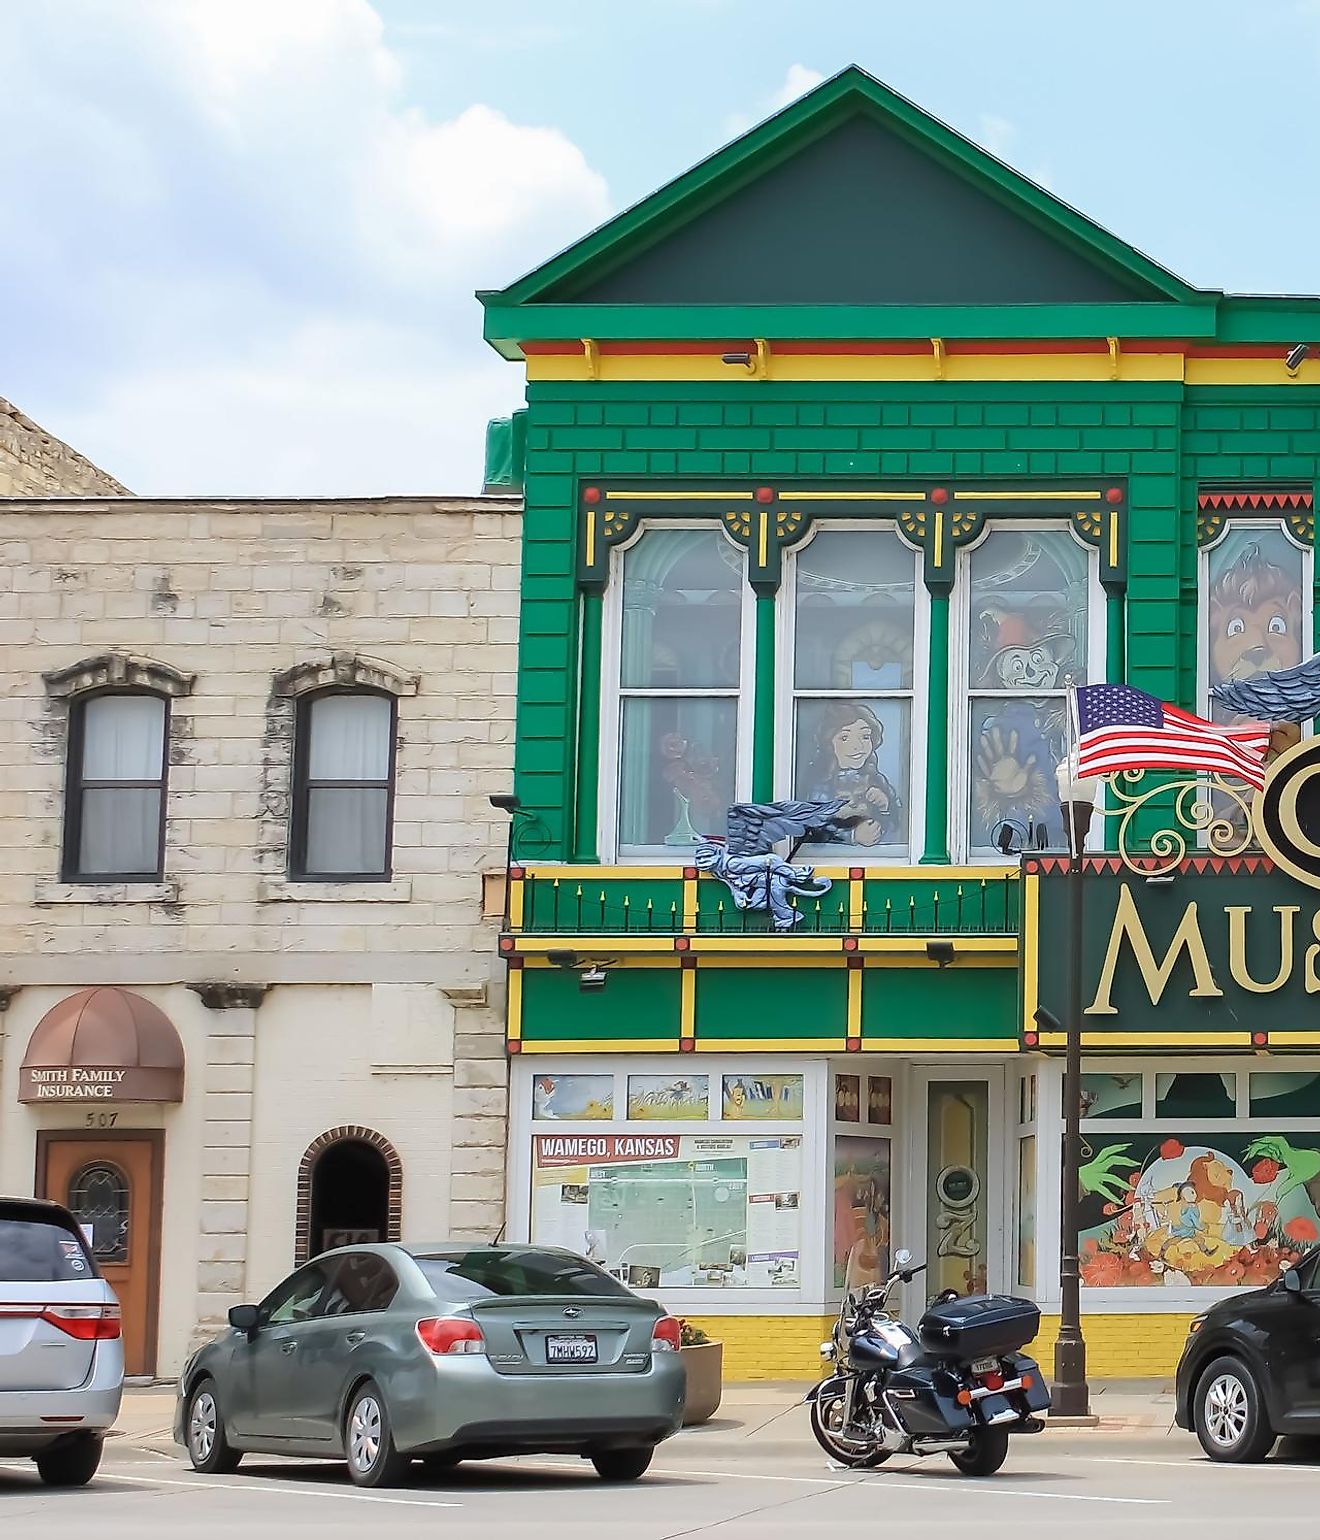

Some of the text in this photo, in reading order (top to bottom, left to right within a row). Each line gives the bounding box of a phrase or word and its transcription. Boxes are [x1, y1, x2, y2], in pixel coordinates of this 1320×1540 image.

[31, 1068, 126, 1082] SMITH FAMILY
[37, 1084, 113, 1098] INSURANCE
[85, 1112, 119, 1128] 507
[541, 1138, 675, 1158] WAMEGO, KANSAS
[550, 1345, 594, 1360] 7MHW592
